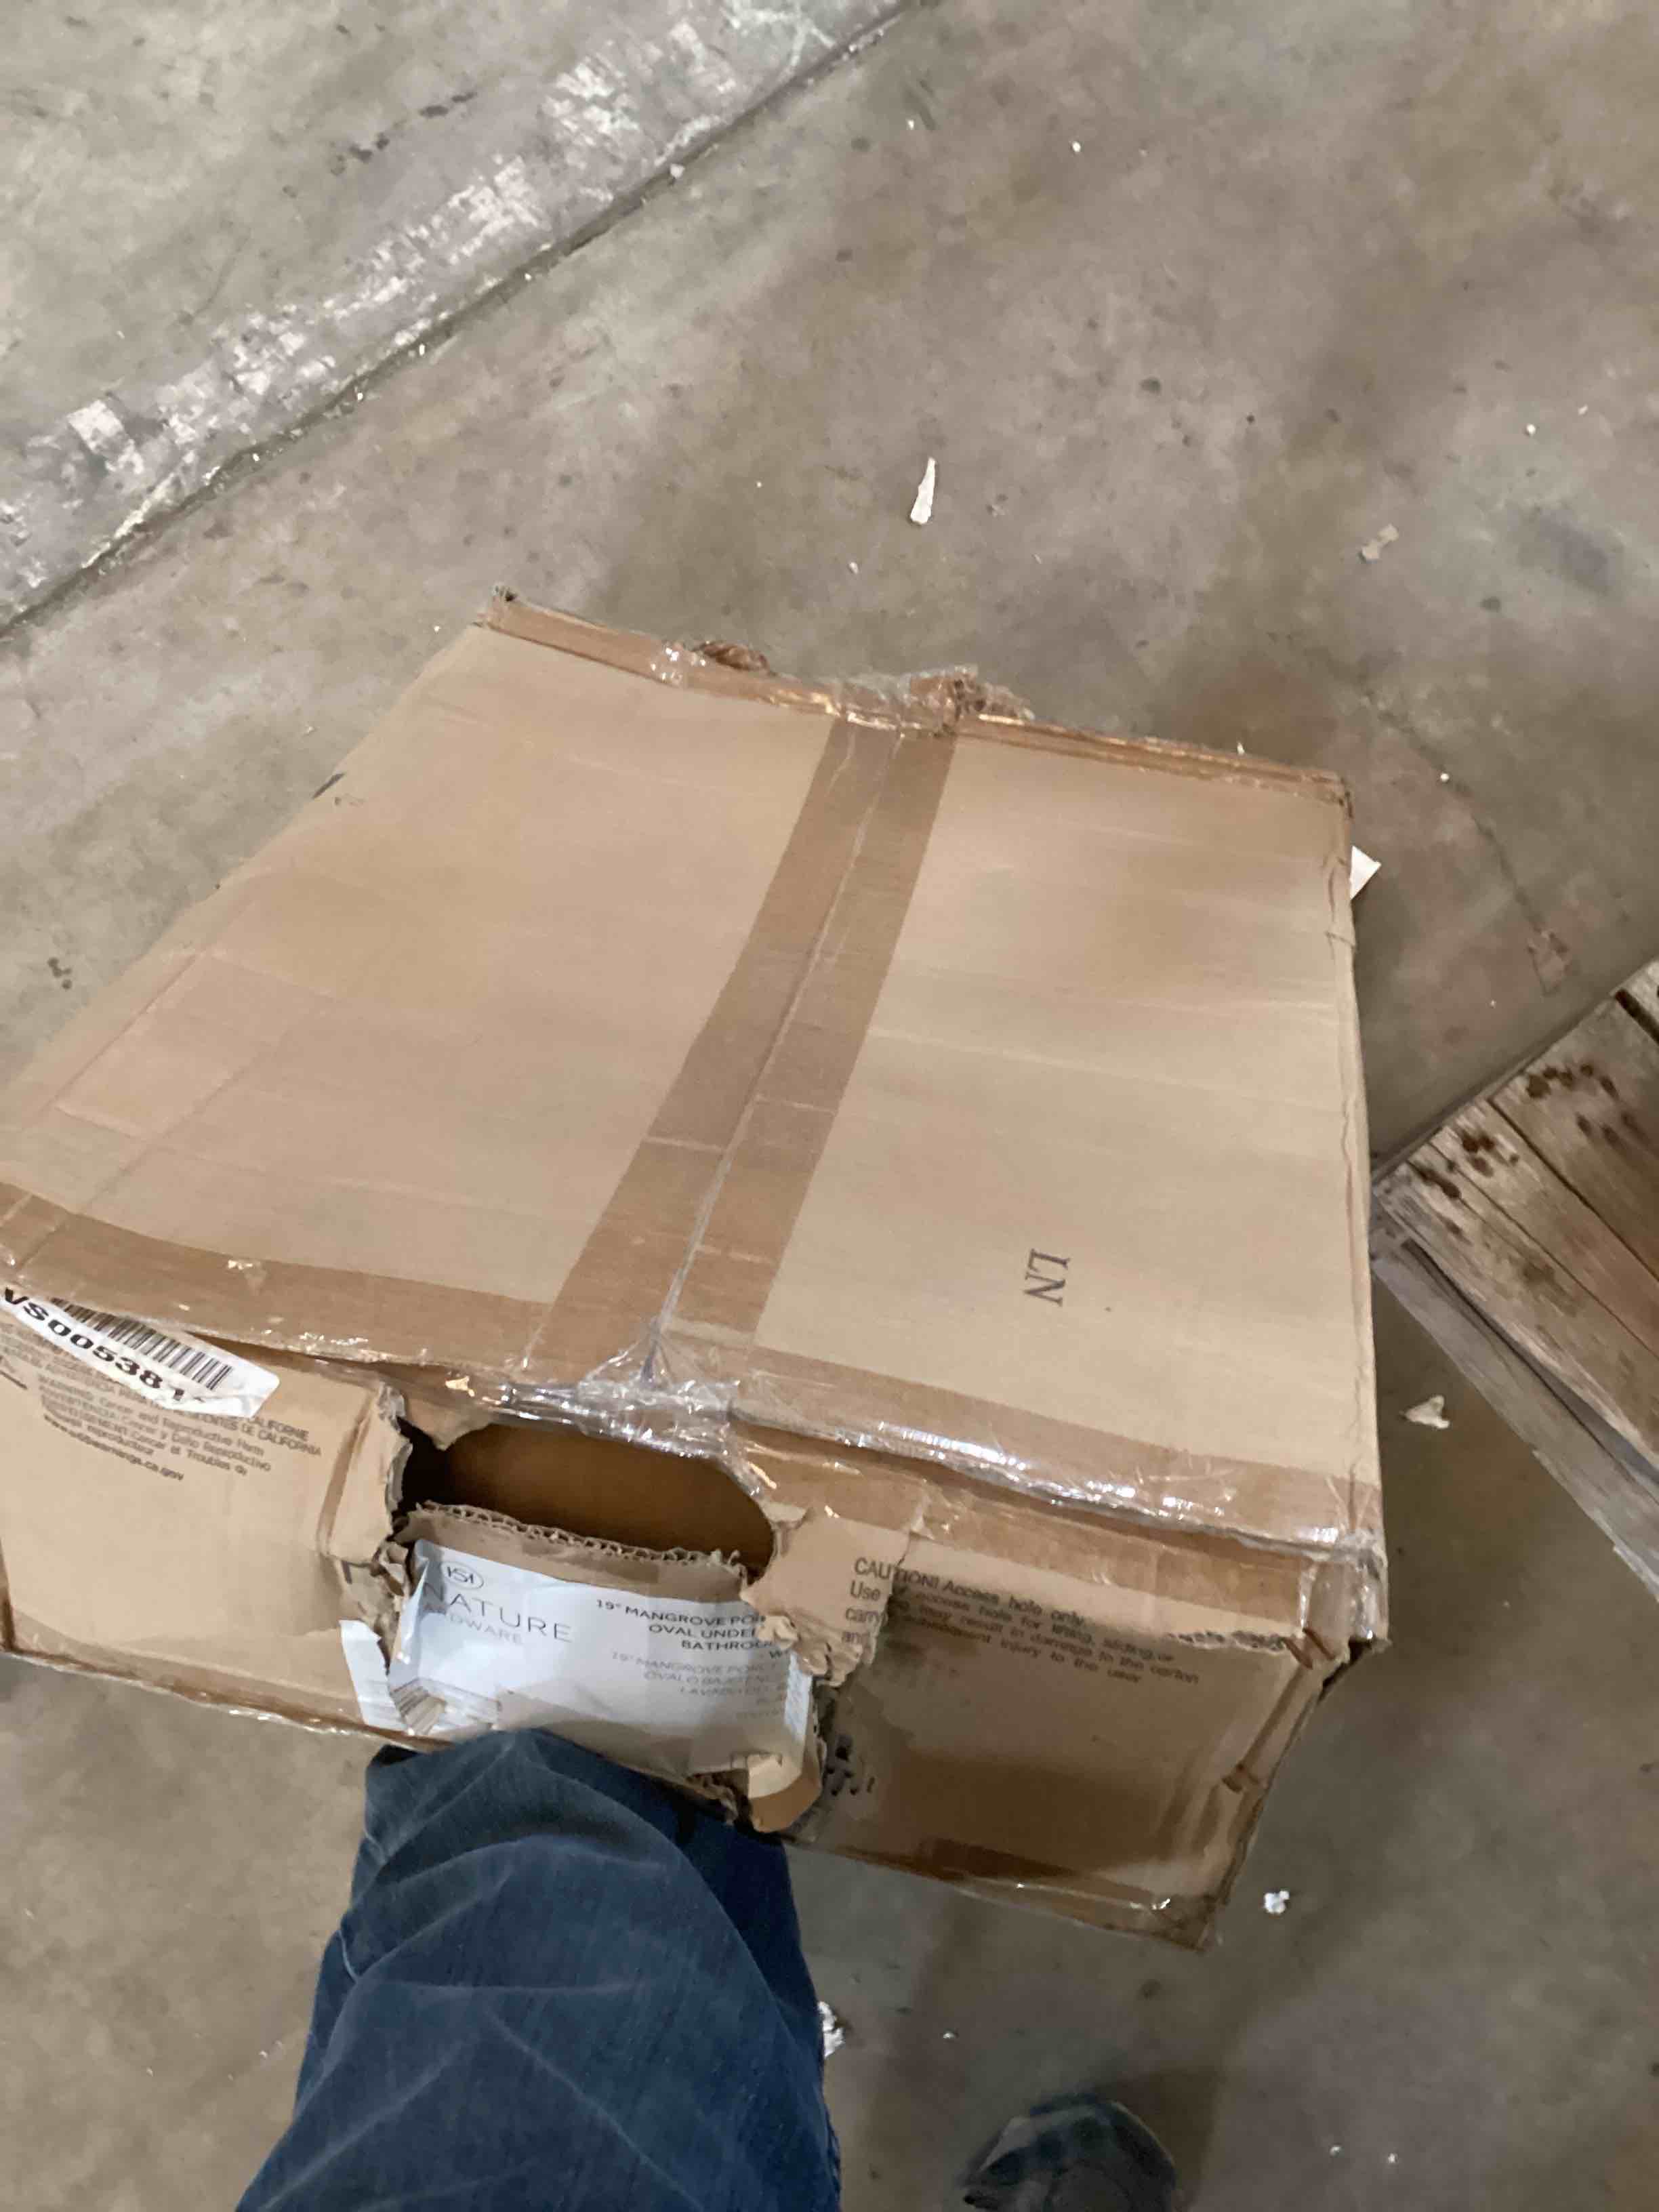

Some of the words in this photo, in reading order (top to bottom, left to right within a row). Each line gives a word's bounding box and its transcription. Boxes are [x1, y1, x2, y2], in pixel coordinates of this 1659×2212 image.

[849, 1580, 882, 1601] Use
[625, 1605, 726, 1626] MANGROVE
[1008, 1595, 1043, 1616] hole
[648, 1624, 697, 1637] OVAL
